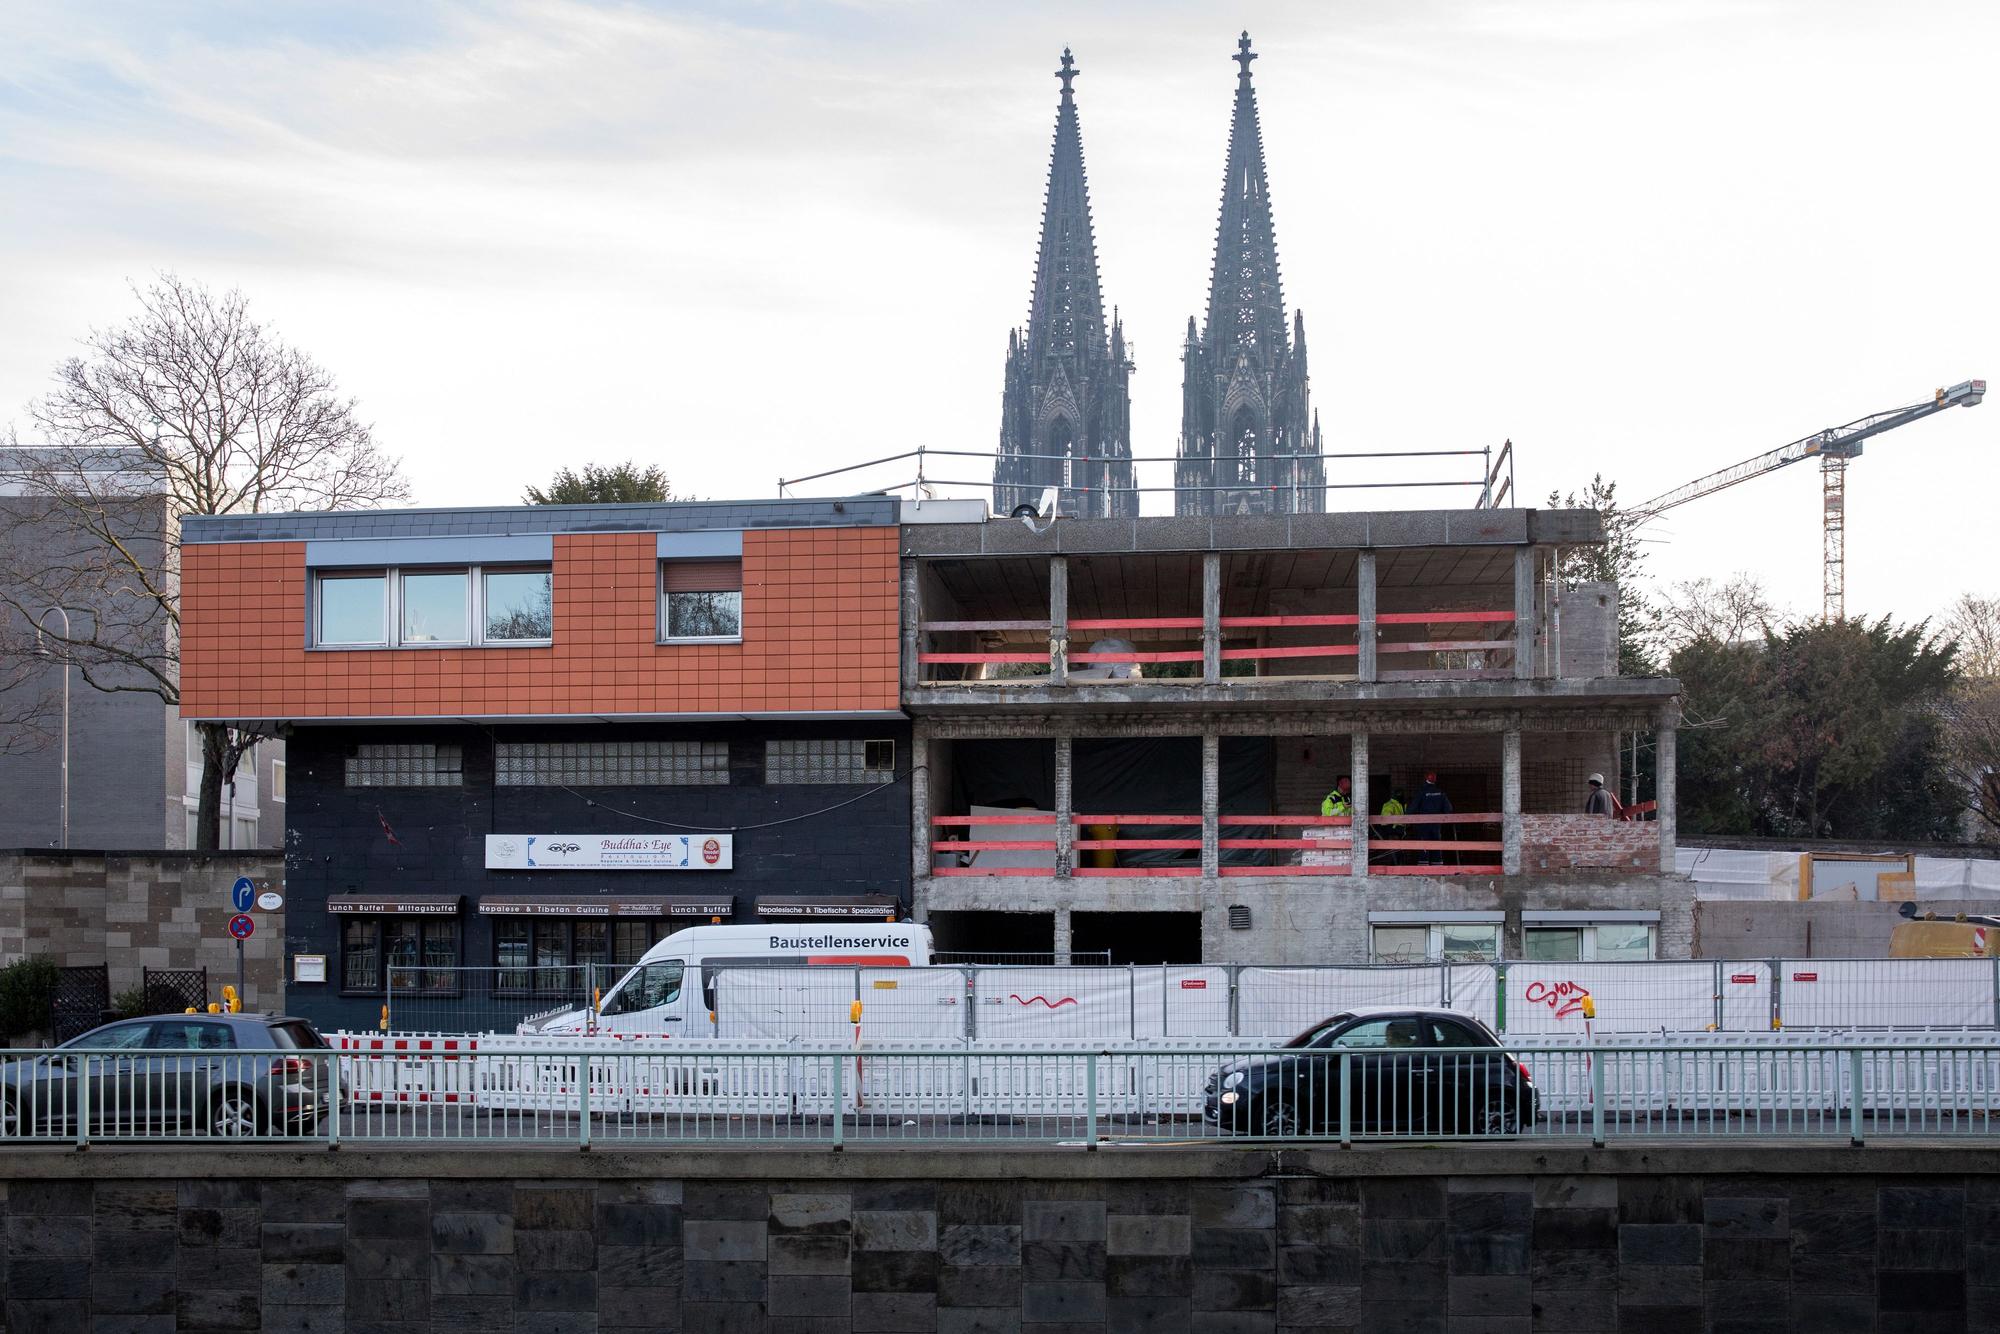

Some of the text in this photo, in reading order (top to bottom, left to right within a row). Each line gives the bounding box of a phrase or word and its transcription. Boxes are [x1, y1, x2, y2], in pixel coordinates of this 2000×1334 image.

[601, 839, 672, 853] Buddha's Eye
[328, 904, 457, 913] Lunch Buffet Mittagsbuffet
[479, 905, 520, 913] Nepalese
[576, 905, 609, 913] Cuisine
[757, 905, 895, 915] Nepalesische & Tibetische Spezialitäten
[769, 935, 910, 949] Baustellenservice
